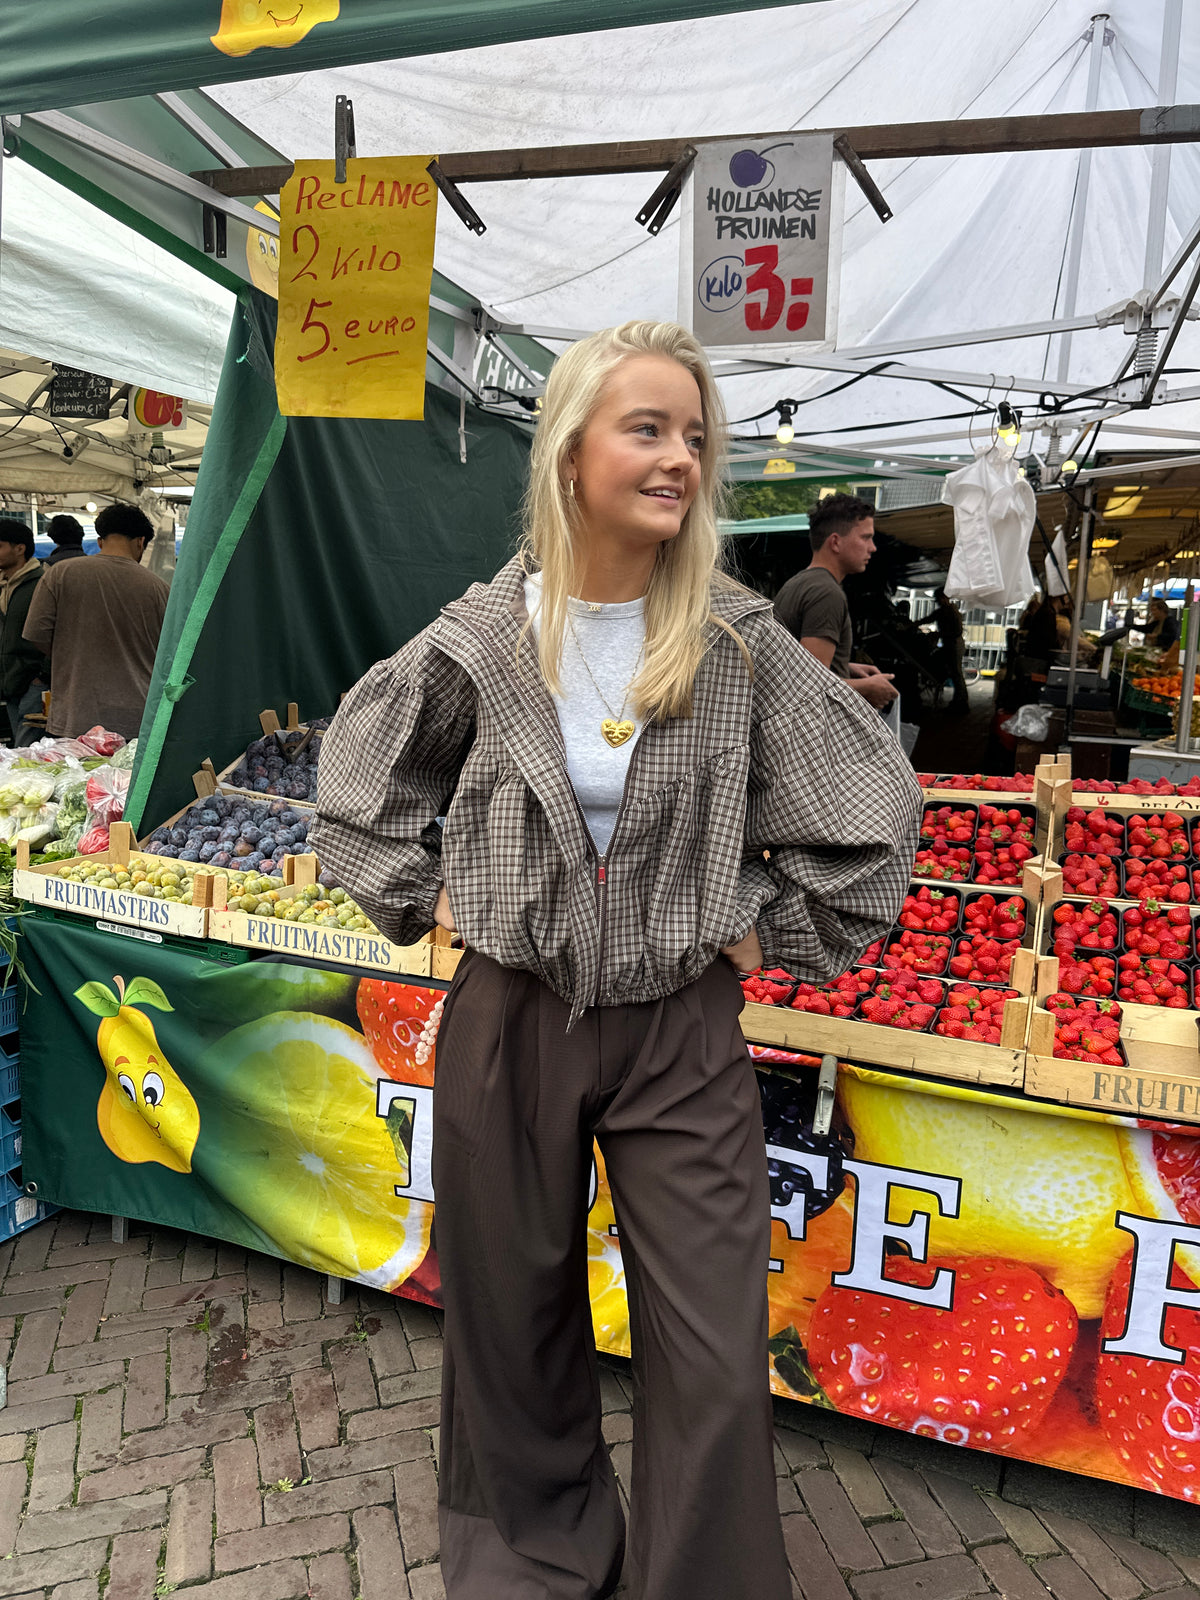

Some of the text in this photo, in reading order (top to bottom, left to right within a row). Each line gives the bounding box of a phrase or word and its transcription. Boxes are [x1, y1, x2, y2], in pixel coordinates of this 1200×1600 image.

[707, 186, 823, 213] HOLLANDSE
[715, 213, 816, 240] PRUIMEN
[289, 224, 320, 283] 2
[45, 878, 169, 926] FRUITMASTERS
[246, 918, 391, 966] FRUITMASTERS
